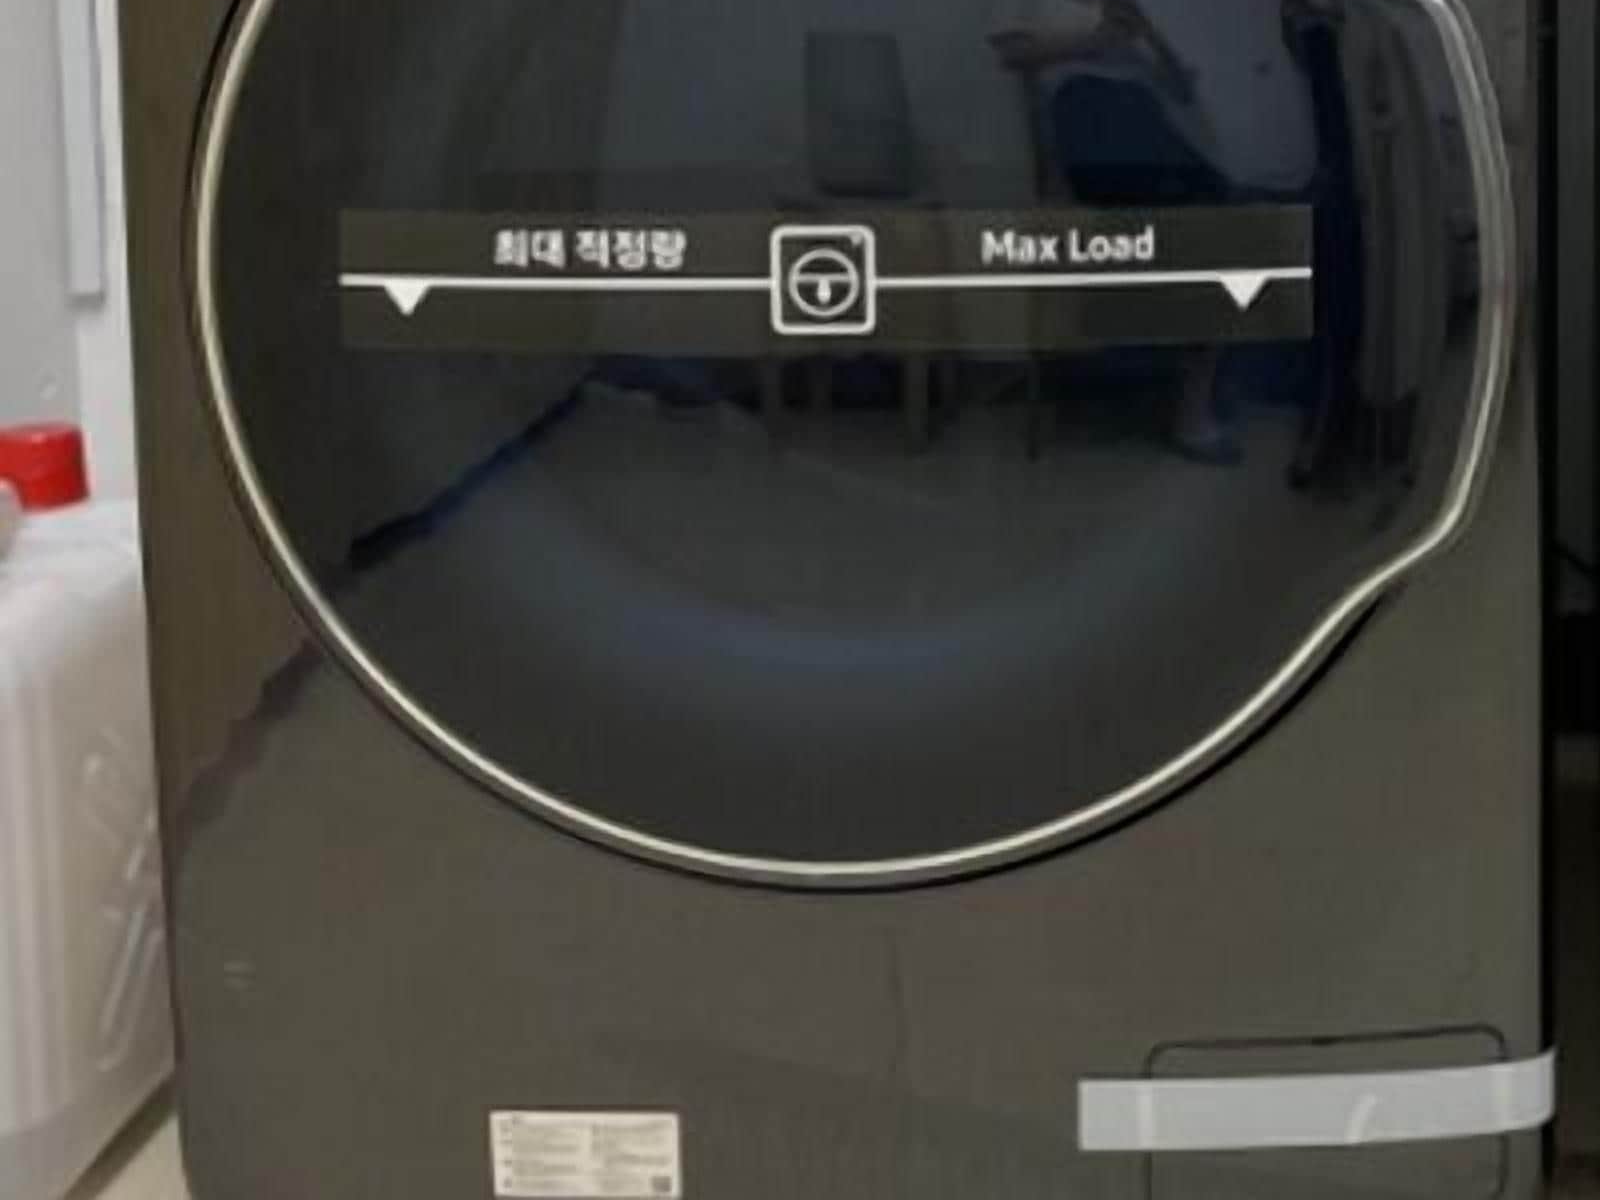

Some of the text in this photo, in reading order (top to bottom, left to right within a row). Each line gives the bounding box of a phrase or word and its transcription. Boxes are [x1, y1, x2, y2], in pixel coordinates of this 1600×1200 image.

[493, 228, 687, 271] 최대 적정량
[980, 224, 1155, 265] Max Load
